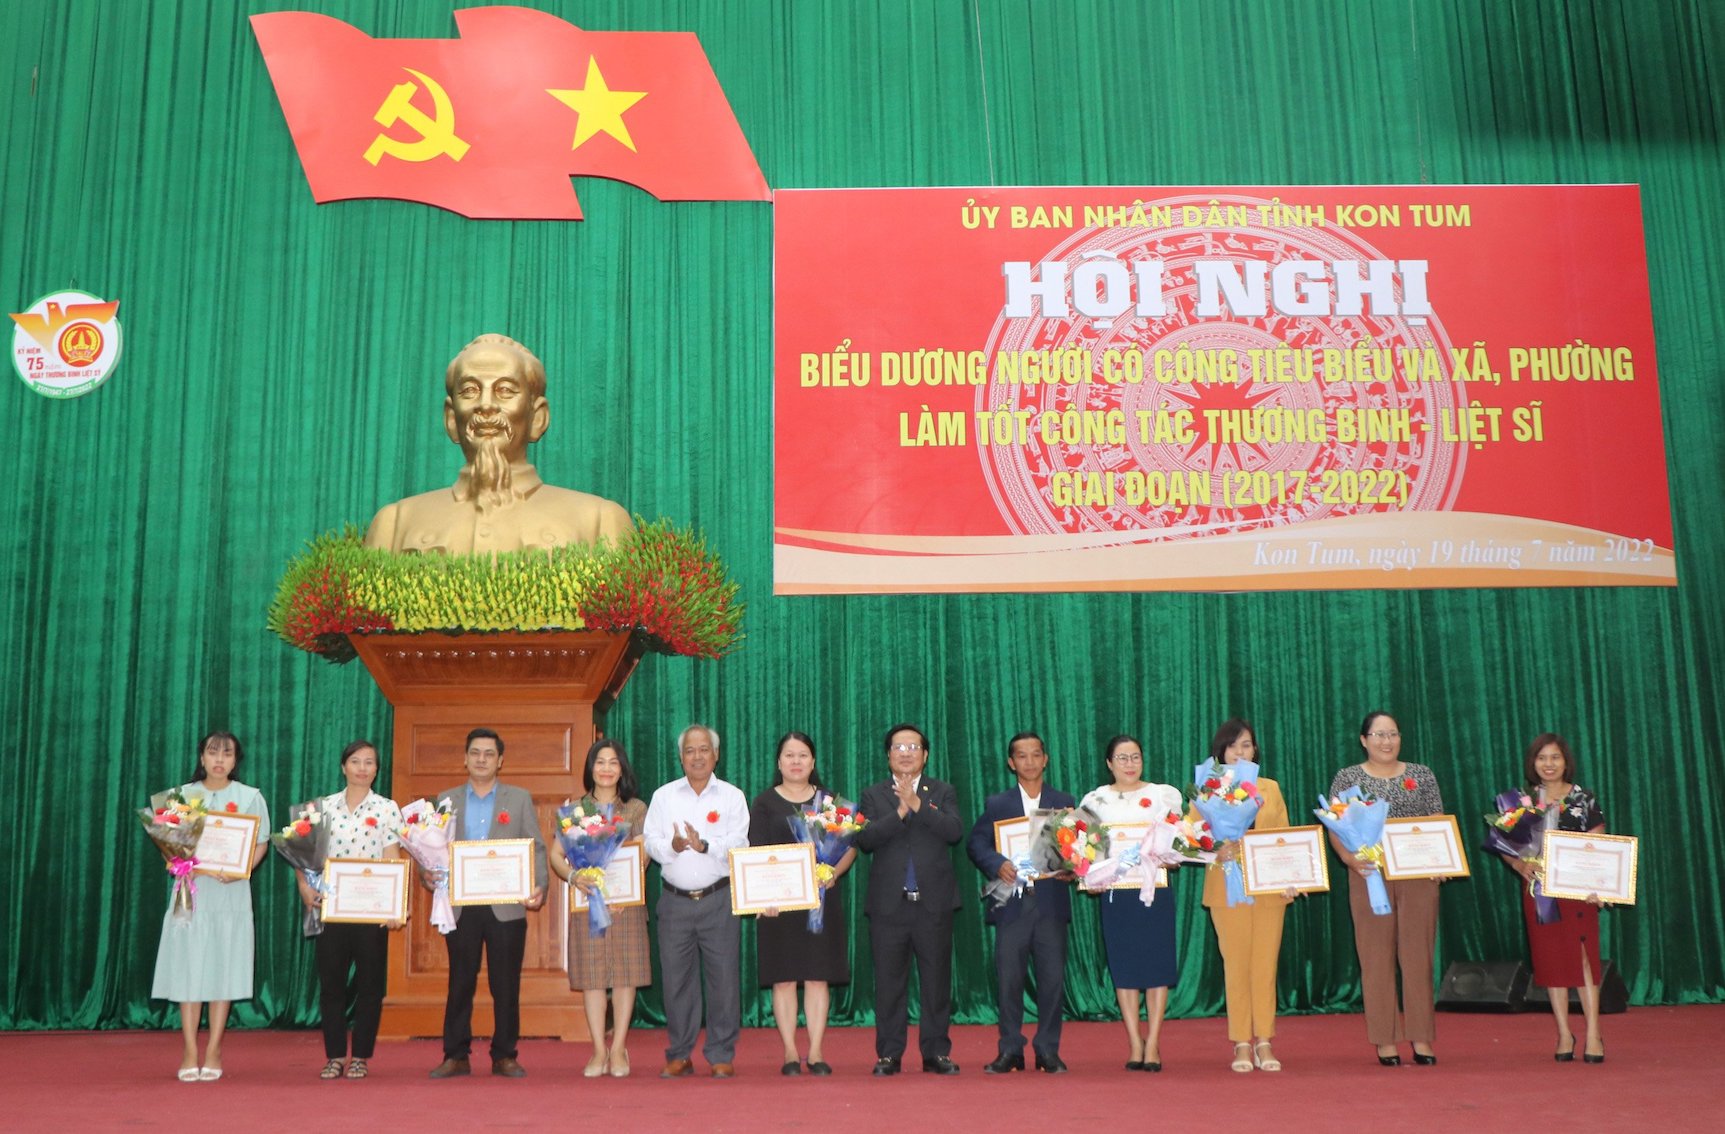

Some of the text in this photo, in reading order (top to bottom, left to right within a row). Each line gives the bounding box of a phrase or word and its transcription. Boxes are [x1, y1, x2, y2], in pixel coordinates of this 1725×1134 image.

[961, 197, 1471, 229] ỦY BAN NHÂN DÂN TỈNH KON TUM
[1002, 249, 1431, 328] HỘI NGHỊ
[27, 357, 44, 370] 75
[801, 335, 1634, 387] BIỂU DƯƠNG NGƯỜI CÓ CÔNG TIÊU BIỂU VÀ XÃ, PHƯỜNG
[899, 400, 1544, 450] LÀM TỐT CÔNG TÁC THƯƠNG BINH - LIỆT SĨ
[1052, 470, 1409, 514] GIAI ĐOẠN (2017-2022)
[1253, 539, 1655, 570] Kon Tum, ngày 19 tháng 7 năm 2022
